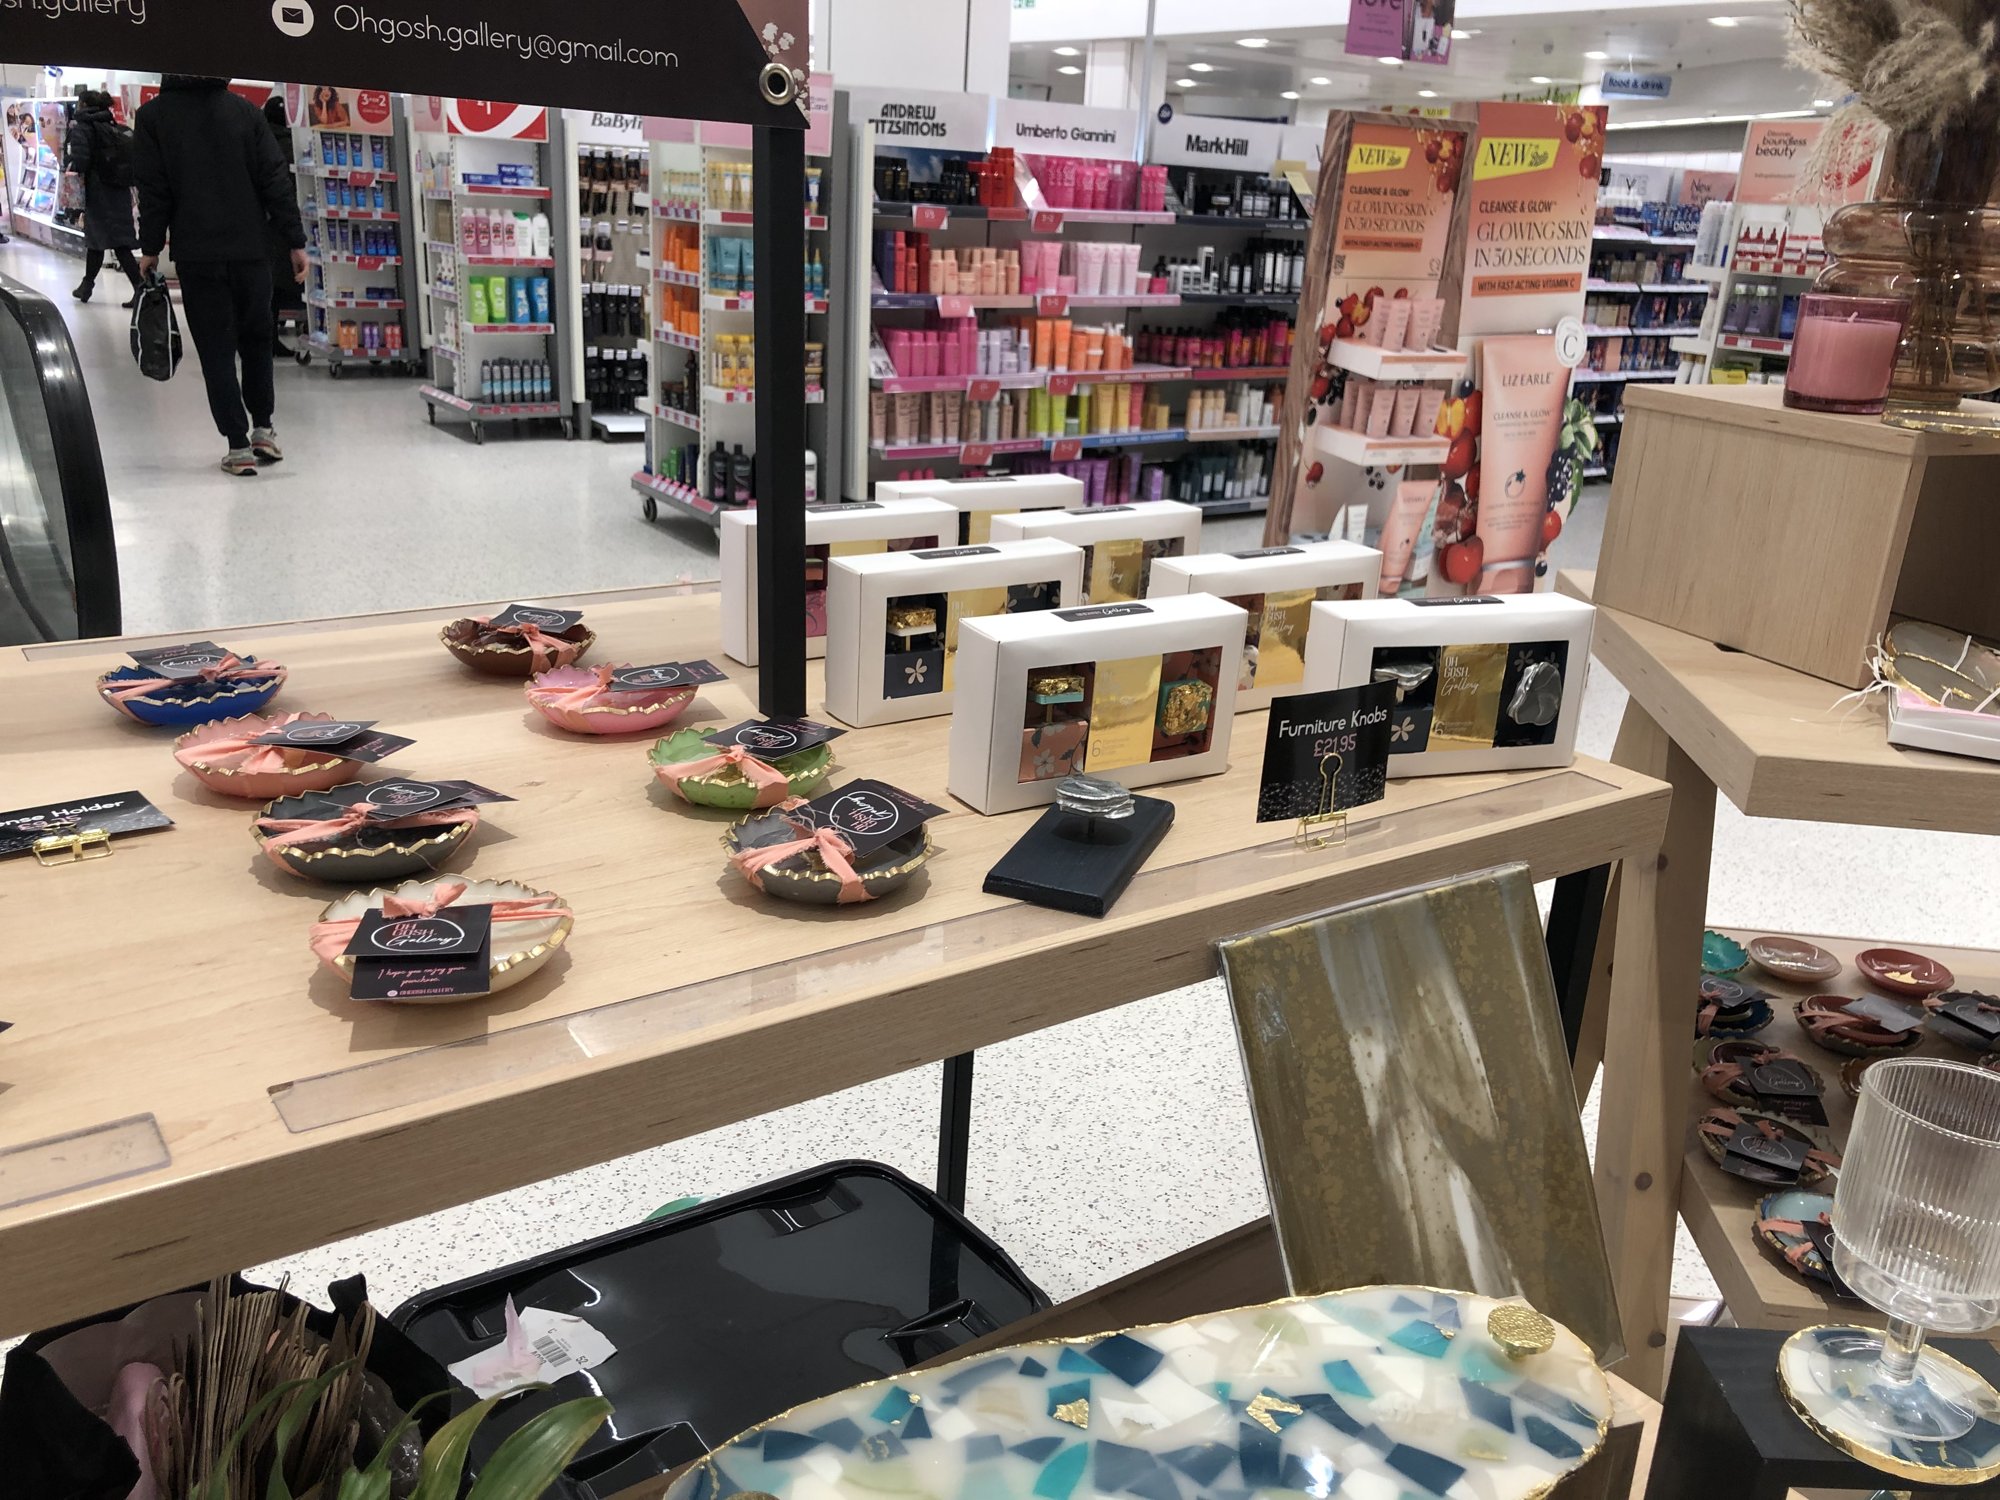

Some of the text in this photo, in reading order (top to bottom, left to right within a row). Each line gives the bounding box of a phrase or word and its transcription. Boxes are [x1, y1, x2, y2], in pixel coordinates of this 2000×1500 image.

[334, 4, 679, 67] Ohgosh.gallery@gmail.com
[361, 94, 369, 106] 3
[378, 95, 387, 107] 2
[880, 103, 936, 120] ANDREW
[868, 118, 947, 137] ITZSIMONS
[1015, 122, 1117, 144] Umberto Giannini
[1762, 136, 1807, 146] boundless
[1355, 147, 1394, 166] NEW
[1483, 142, 1533, 167] NEW
[1755, 144, 1796, 160] beauty
[1349, 186, 1381, 196] CLEANSE
[1389, 187, 1410, 197] GLOW
[1346, 200, 1428, 216] GLOWING SKIN
[1479, 200, 1552, 214] CLEANSE & GLOW
[1343, 217, 1359, 230] IN
[1373, 218, 1426, 233] SECONDS
[1476, 220, 1589, 241] GLOWING SKIN
[1474, 247, 1492, 268] IN
[1514, 245, 1586, 267] SECONDS
[1477, 281, 1496, 292] WITH
[1542, 278, 1570, 290] VITAMIN
[1570, 278, 1576, 288] C
[1563, 335, 1578, 359] C
[1501, 372, 1551, 388] LIZ EARLE
[1445, 655, 1459, 667] OH
[1440, 677, 1480, 697] Gallery
[1279, 705, 1388, 739] Furniture Knobs
[1313, 733, 1358, 757] £21.95
[50, 801, 125, 818] Holder
[386, 934, 455, 947] Gallery
